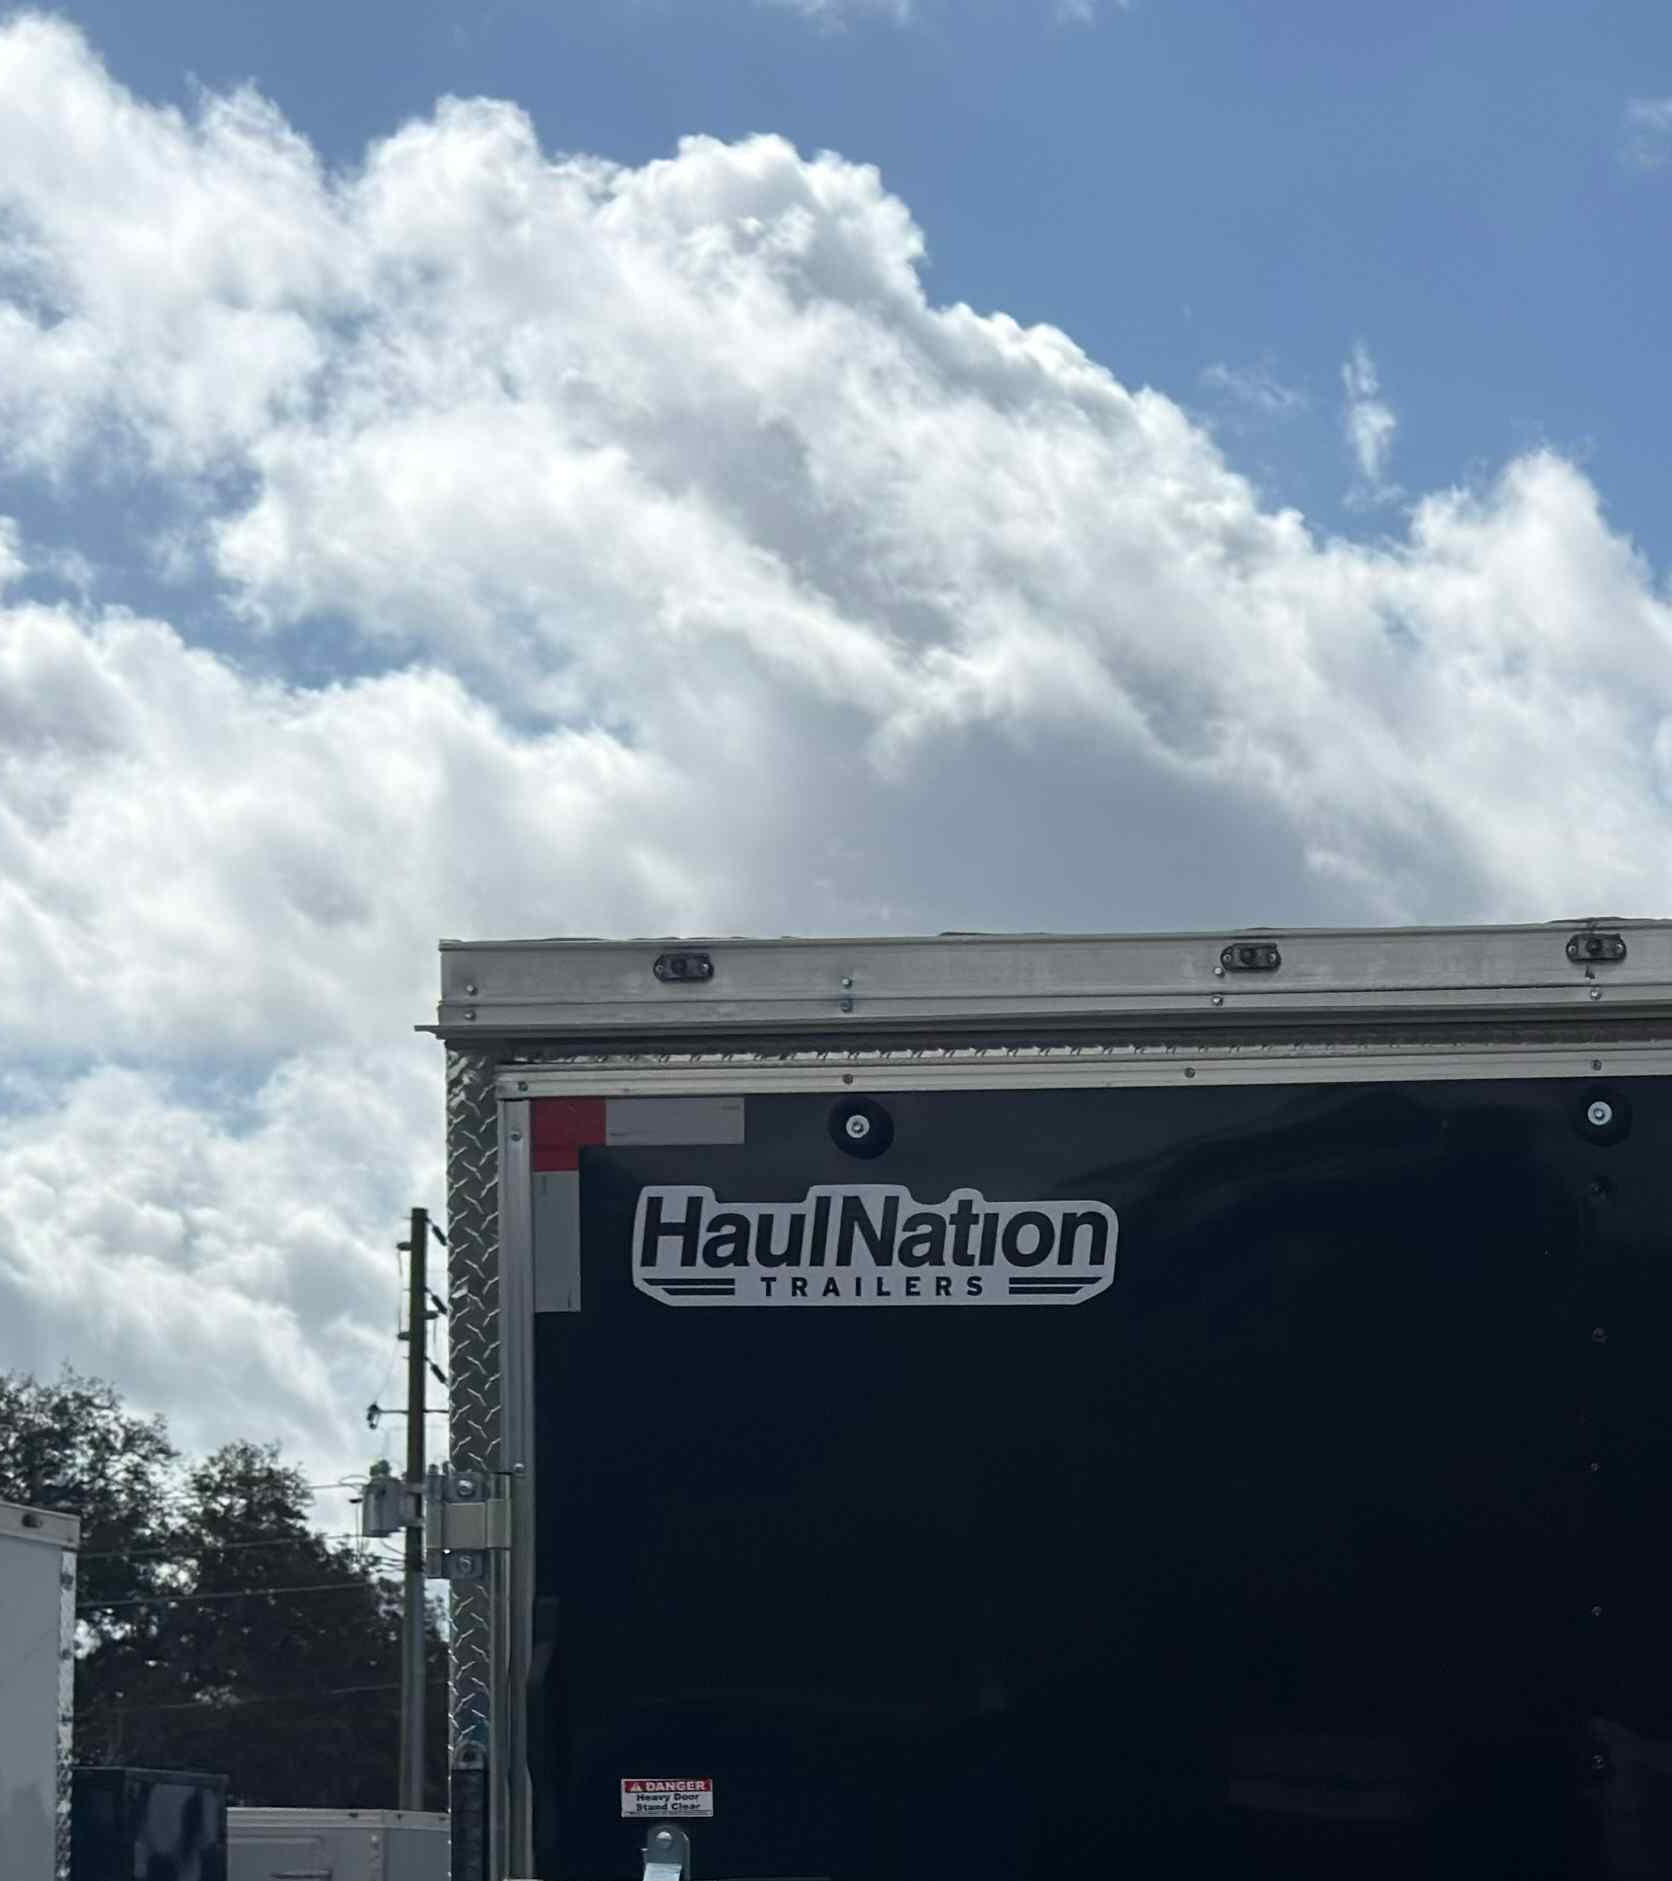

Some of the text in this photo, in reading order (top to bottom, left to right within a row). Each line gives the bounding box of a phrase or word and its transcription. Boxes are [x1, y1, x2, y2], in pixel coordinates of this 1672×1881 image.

[639, 1195, 1109, 1268] HaulNation
[760, 1275, 984, 1297] TRAILERS
[646, 1781, 705, 1791] DANGER
[637, 1793, 670, 1802] Heavy
[636, 1803, 668, 1811] Stand
